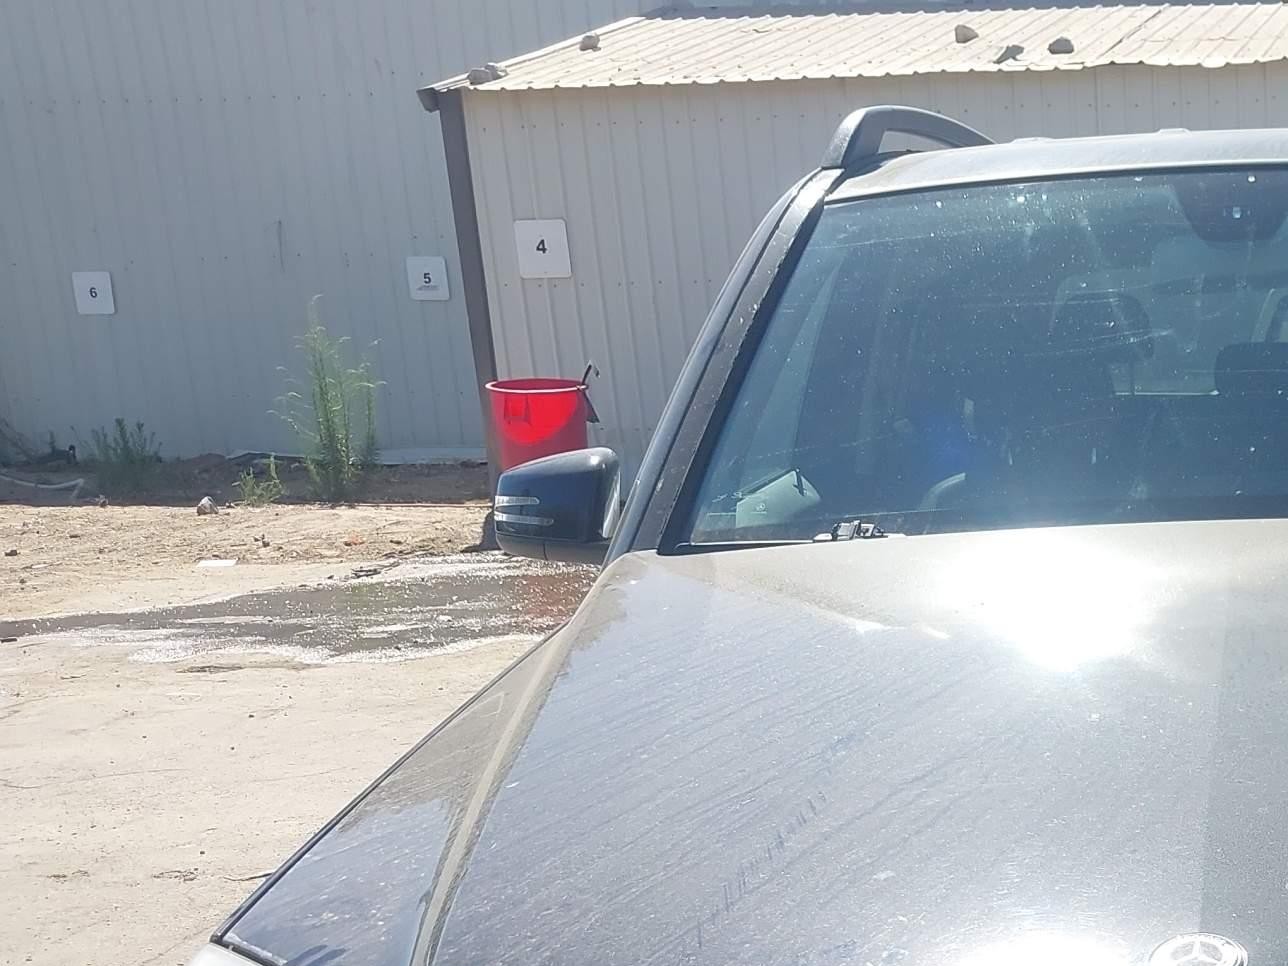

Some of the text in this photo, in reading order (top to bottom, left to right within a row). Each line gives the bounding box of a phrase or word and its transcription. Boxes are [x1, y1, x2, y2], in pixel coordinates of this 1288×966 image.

[536, 239, 548, 254] 4
[423, 272, 432, 285] 5
[89, 287, 98, 298] 6
